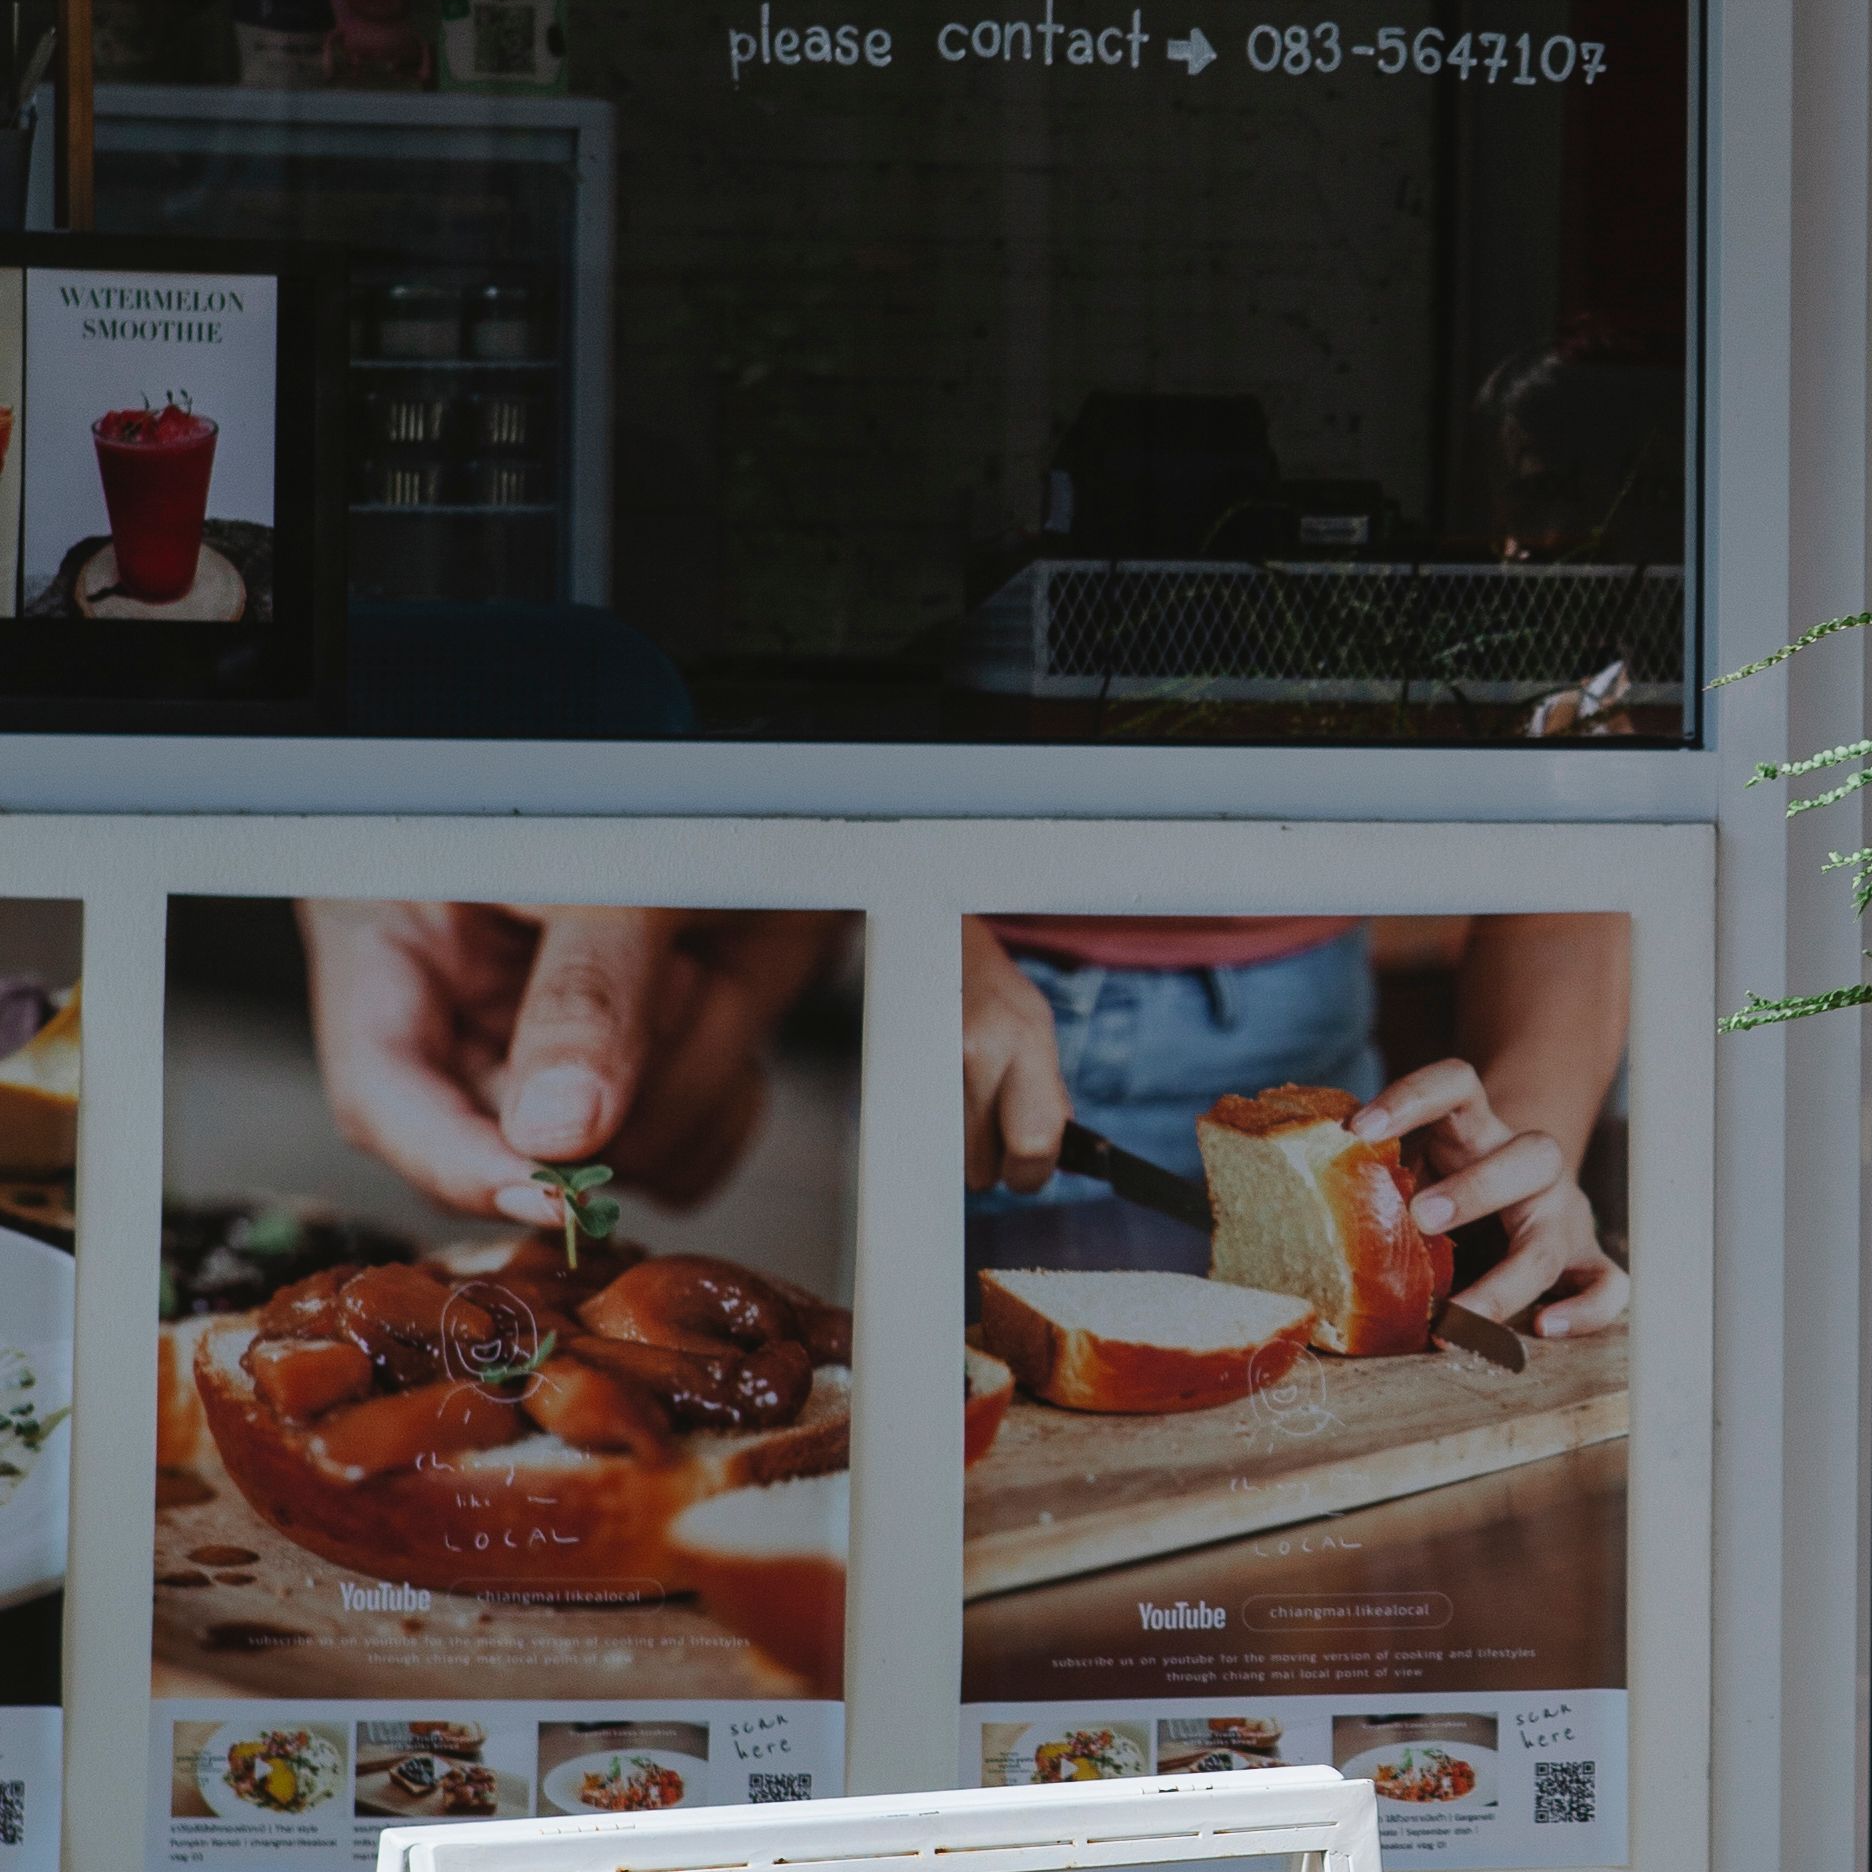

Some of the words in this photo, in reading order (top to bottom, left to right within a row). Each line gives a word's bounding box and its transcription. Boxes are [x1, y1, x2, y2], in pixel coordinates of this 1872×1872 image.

[729, 2, 893, 86] please
[1246, 21, 1607, 86] 083-5647107
[59, 285, 245, 314] WATERMELON
[82, 318, 224, 345] SMOOTHIE
[339, 1581, 432, 1613] YouTube
[1138, 1600, 1226, 1631] YouTube
[1052, 1657, 1114, 1668] subscribe
[1120, 1658, 1135, 1668] us
[1140, 1657, 1156, 1666] on
[1162, 1654, 1215, 1667] youtube
[1220, 1654, 1238, 1664] for
[1244, 1653, 1265, 1664] the
[1270, 1653, 1317, 1666] moving
[1323, 1651, 1371, 1662] version
[1376, 1650, 1389, 1661] of
[1395, 1650, 1443, 1664] cooking
[1450, 1649, 1472, 1660] and
[1478, 1648, 1536, 1661] lifestyles
[1166, 1671, 1217, 1683] through
[1222, 1671, 1265, 1683] chiang
[1270, 1670, 1294, 1680] mai
[1299, 1669, 1329, 1680] local
[1336, 1668, 1369, 1681] point
[1375, 1668, 1388, 1678] of
[1394, 1667, 1423, 1678] view
[730, 1714, 789, 1736] scan
[1516, 1703, 1571, 1726] scan
[735, 1739, 791, 1760] here
[1521, 1727, 1575, 1749] here
